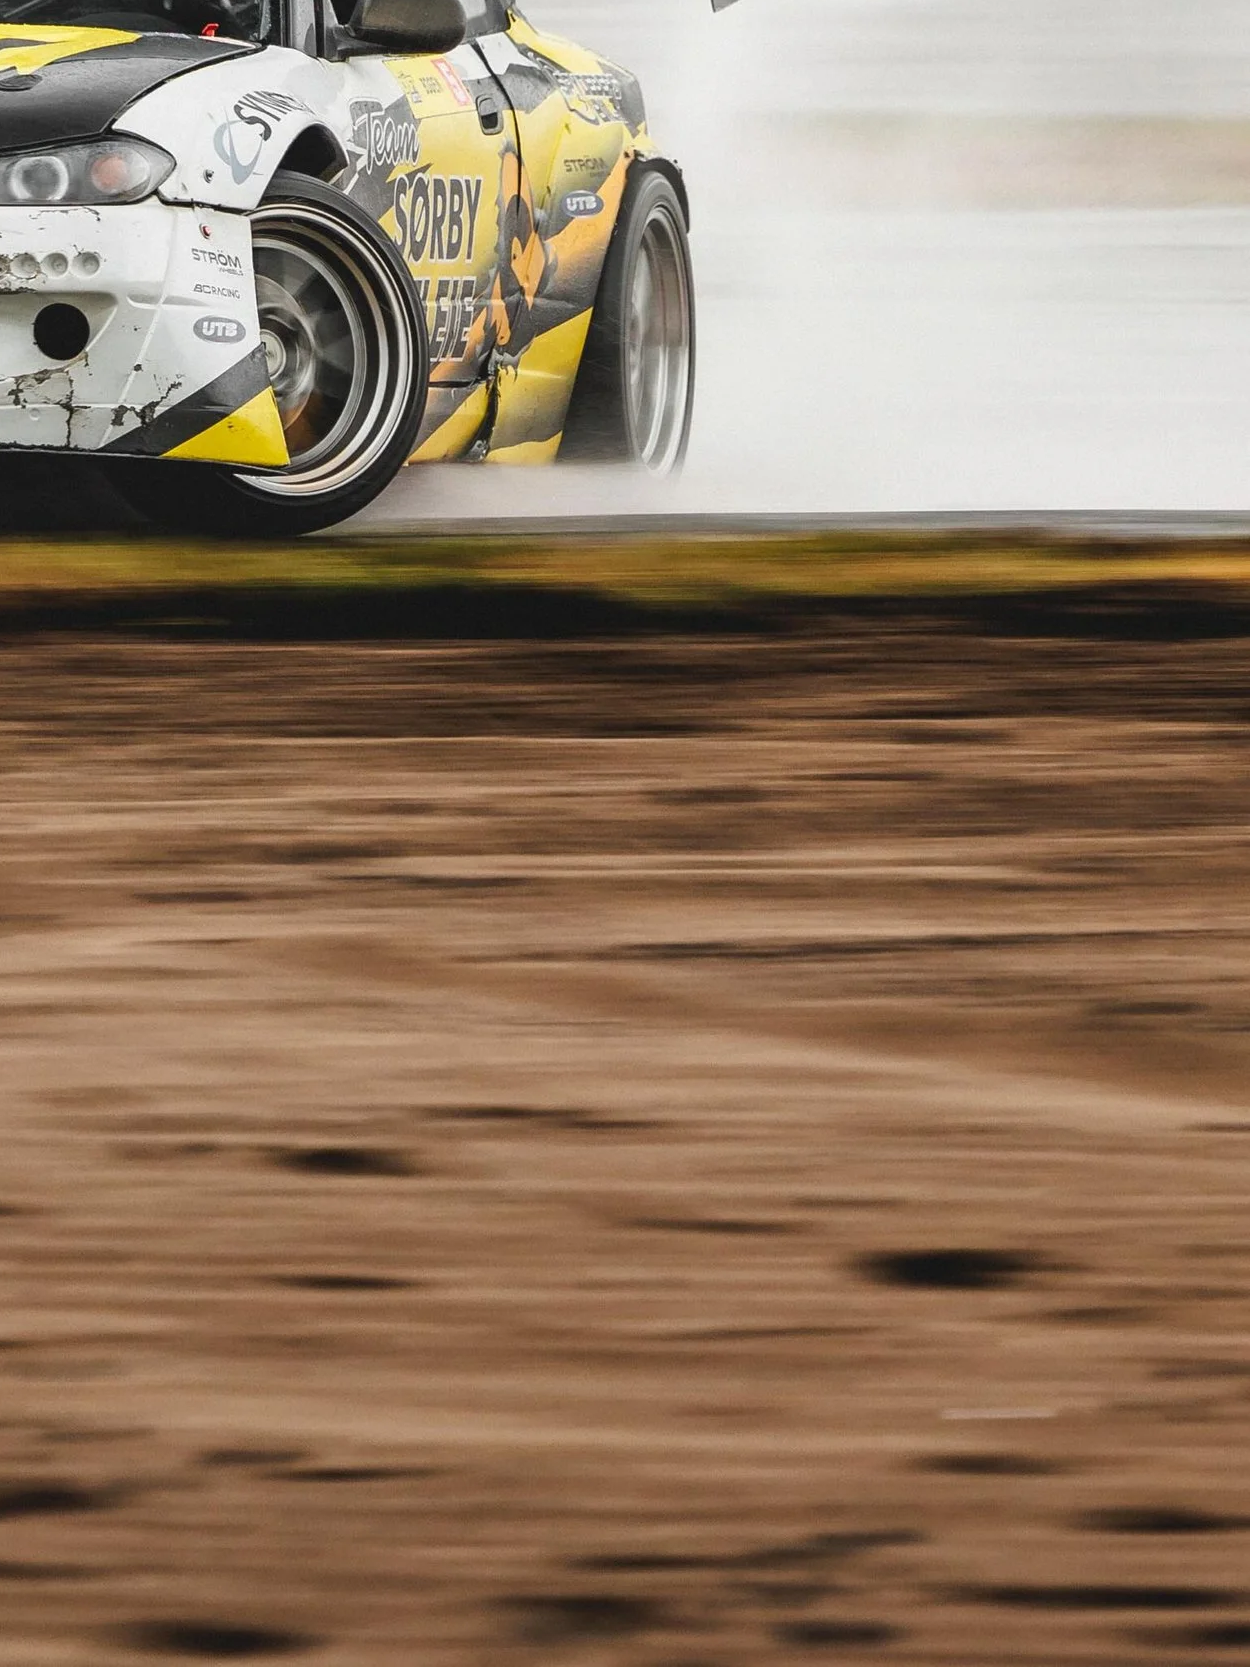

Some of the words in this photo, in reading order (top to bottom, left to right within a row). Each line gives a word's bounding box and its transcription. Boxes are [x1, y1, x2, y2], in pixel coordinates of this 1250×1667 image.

[349, 96, 421, 175] Team
[565, 195, 597, 212] UTB
[394, 172, 483, 265] SØRBY
[191, 248, 242, 269] STRÖM
[211, 285, 241, 300] RACING
[202, 320, 238, 338] UTB
